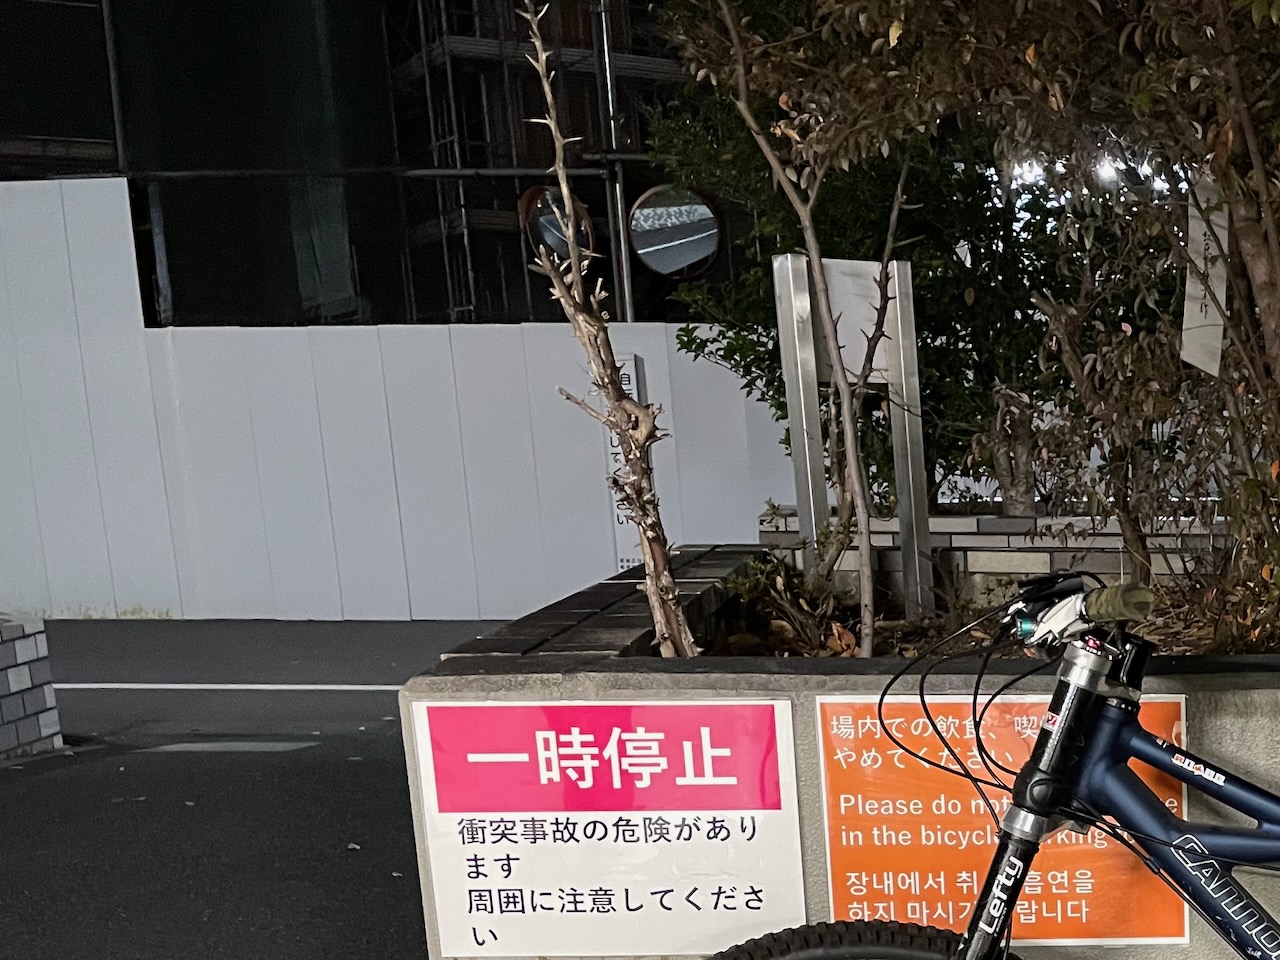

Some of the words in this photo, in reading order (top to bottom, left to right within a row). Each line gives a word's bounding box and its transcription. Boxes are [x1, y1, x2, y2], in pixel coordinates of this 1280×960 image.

[830, 714, 1046, 740] 場内での飲食、喫
[466, 726, 738, 790] 一時停止
[833, 747, 1014, 770] やめてください
[839, 793, 923, 815] Please
[932, 793, 962, 815] do
[970, 795, 1012, 815] not
[457, 816, 758, 845] 衝突事故の危険があり
[841, 825, 863, 846] in
[872, 825, 912, 846] the
[465, 853, 521, 880] ます
[845, 871, 946, 896] 장내에서
[1023, 869, 1096, 895] 흡연을
[978, 855, 1024, 934] Lefty
[467, 884, 765, 915] 周囲に注意してくださ
[848, 900, 895, 923] 하지
[1016, 899, 1090, 924] 랍니다
[473, 927, 499, 947] い
